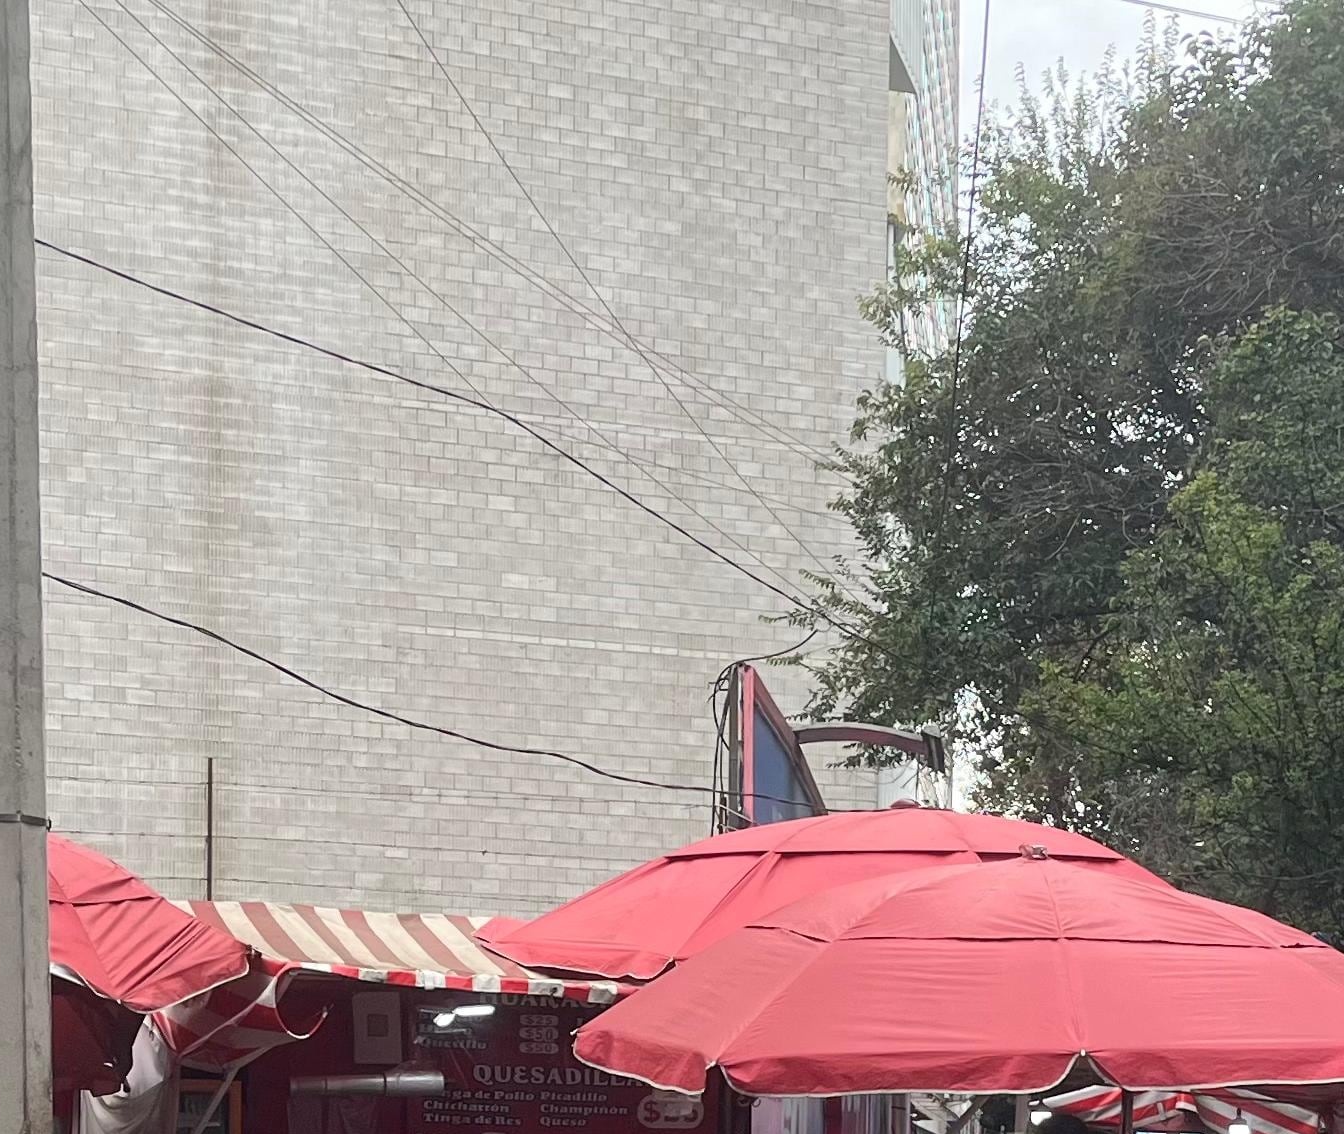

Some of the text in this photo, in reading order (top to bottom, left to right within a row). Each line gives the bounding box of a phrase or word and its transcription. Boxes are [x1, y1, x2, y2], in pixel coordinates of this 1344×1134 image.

[473, 1063, 645, 1087] QUESADILL
[475, 1090, 491, 1099] de
[494, 1090, 535, 1101] Pollo
[540, 1091, 608, 1102] Picadillo
[423, 1113, 521, 1126] Tinga de Res
[539, 1116, 587, 1128] Queso
